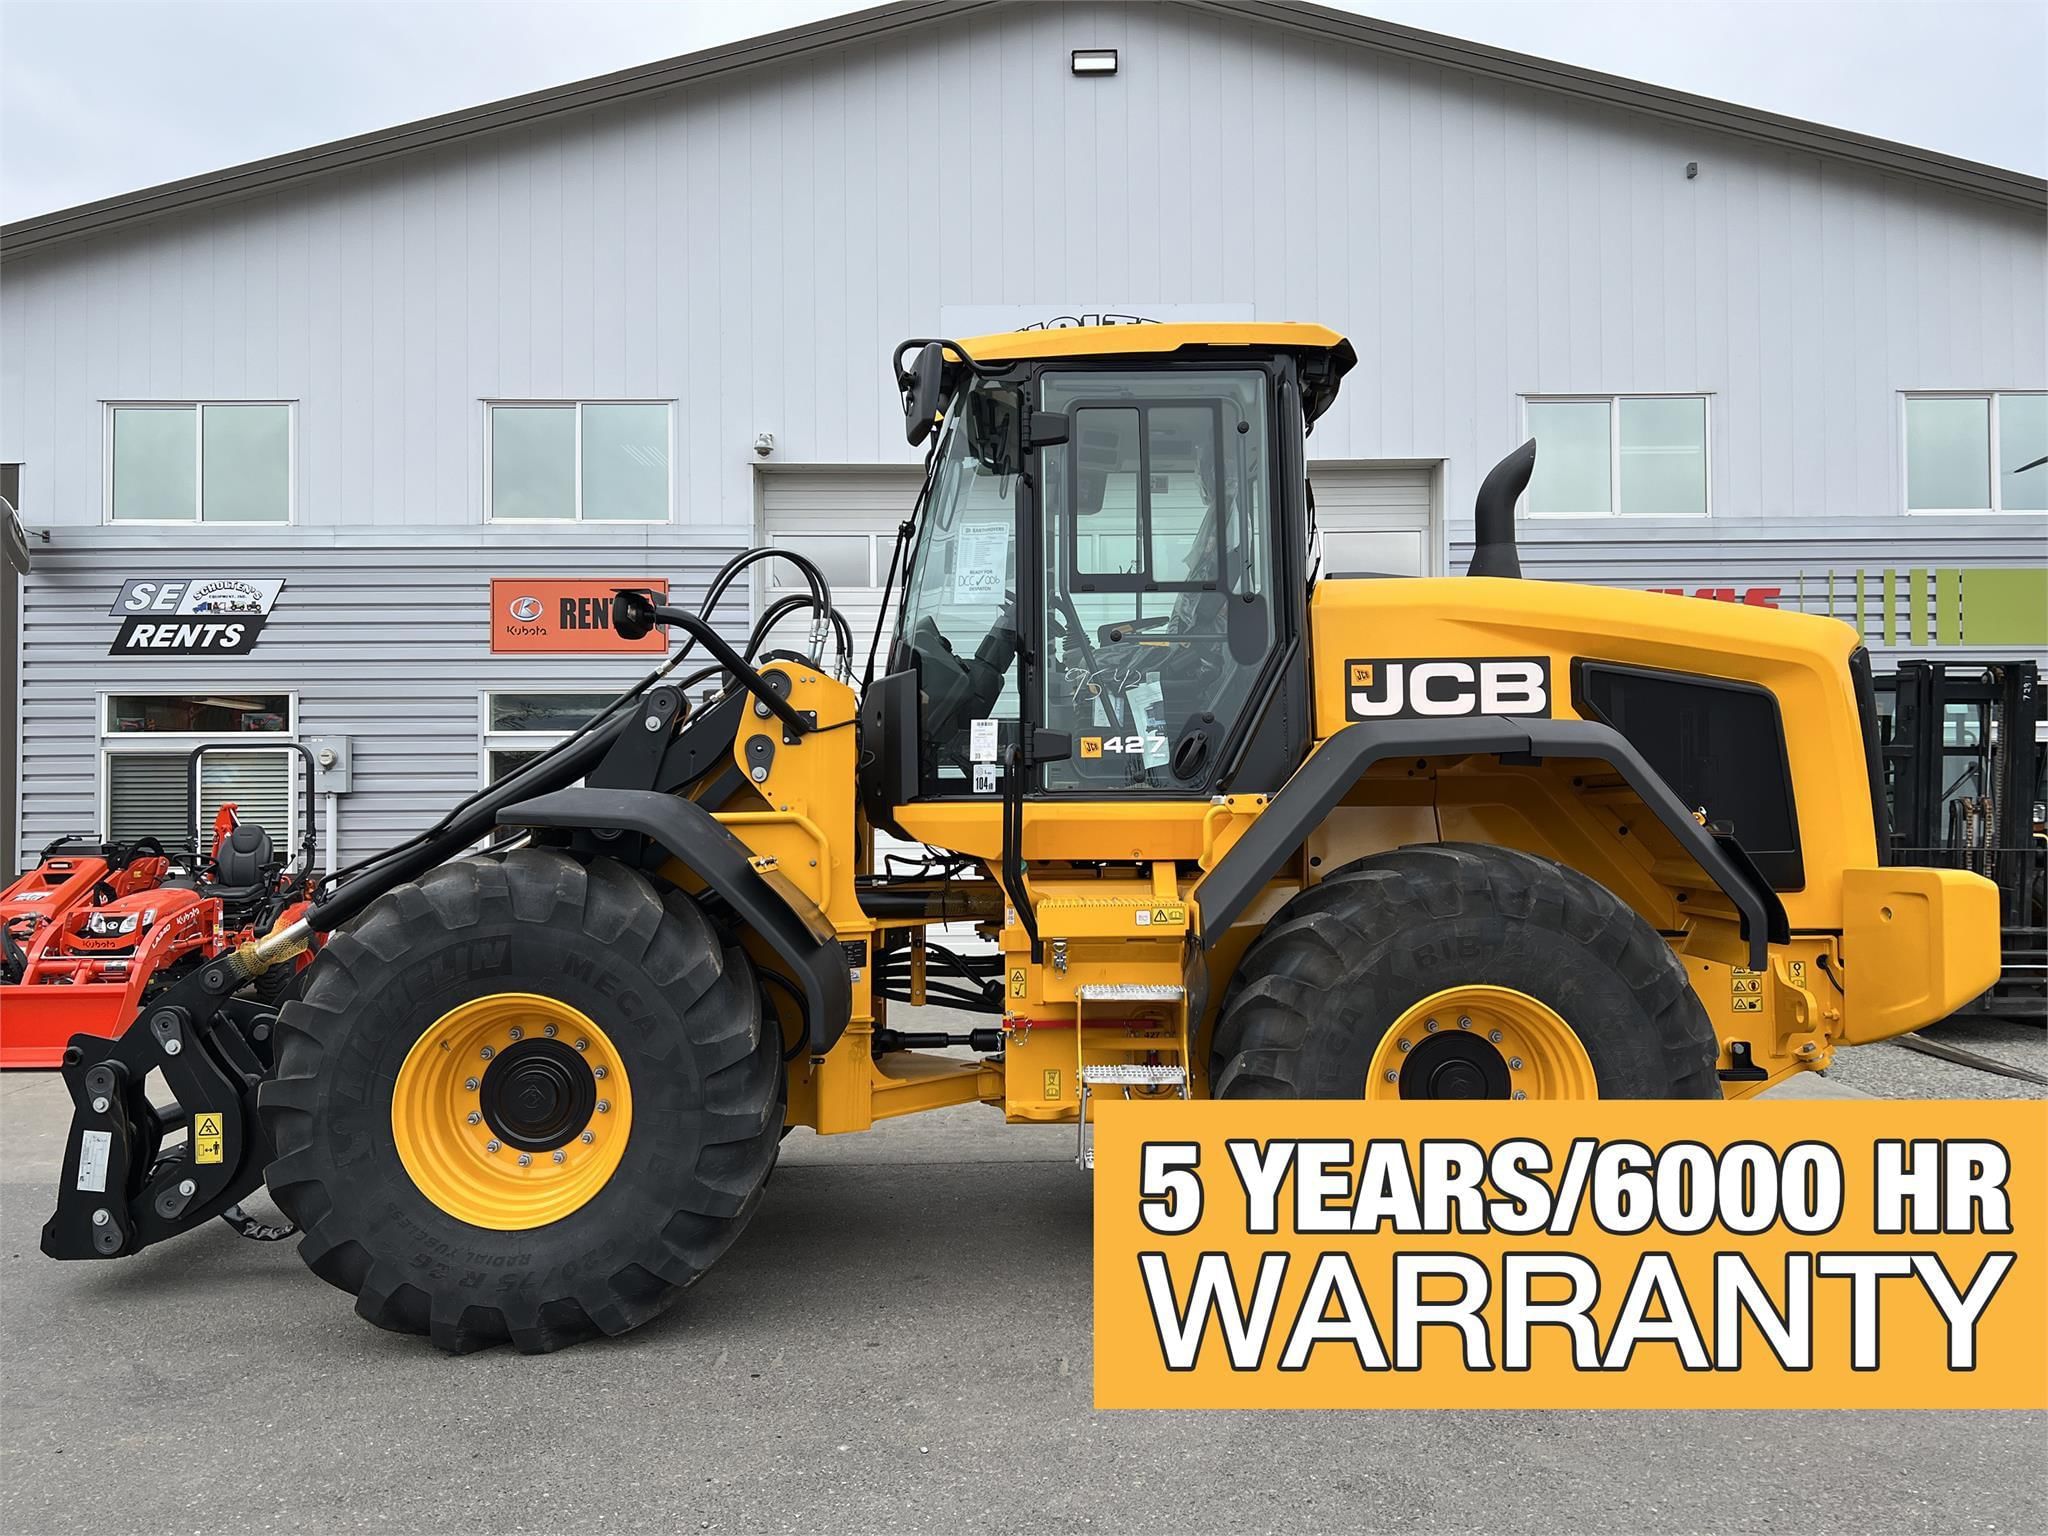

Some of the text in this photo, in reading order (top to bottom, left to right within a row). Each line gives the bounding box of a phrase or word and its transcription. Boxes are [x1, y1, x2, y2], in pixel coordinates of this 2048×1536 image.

[124, 582, 187, 611] SE
[193, 580, 264, 601] SCHOLTEN'S
[126, 623, 246, 648] RENTS
[506, 625, 547, 636] Kubota
[1351, 661, 1547, 716] JCB
[1103, 736, 1167, 754] 427
[975, 776, 988, 790] 104
[176, 907, 200, 925] Kubota
[82, 940, 116, 949] Kubota
